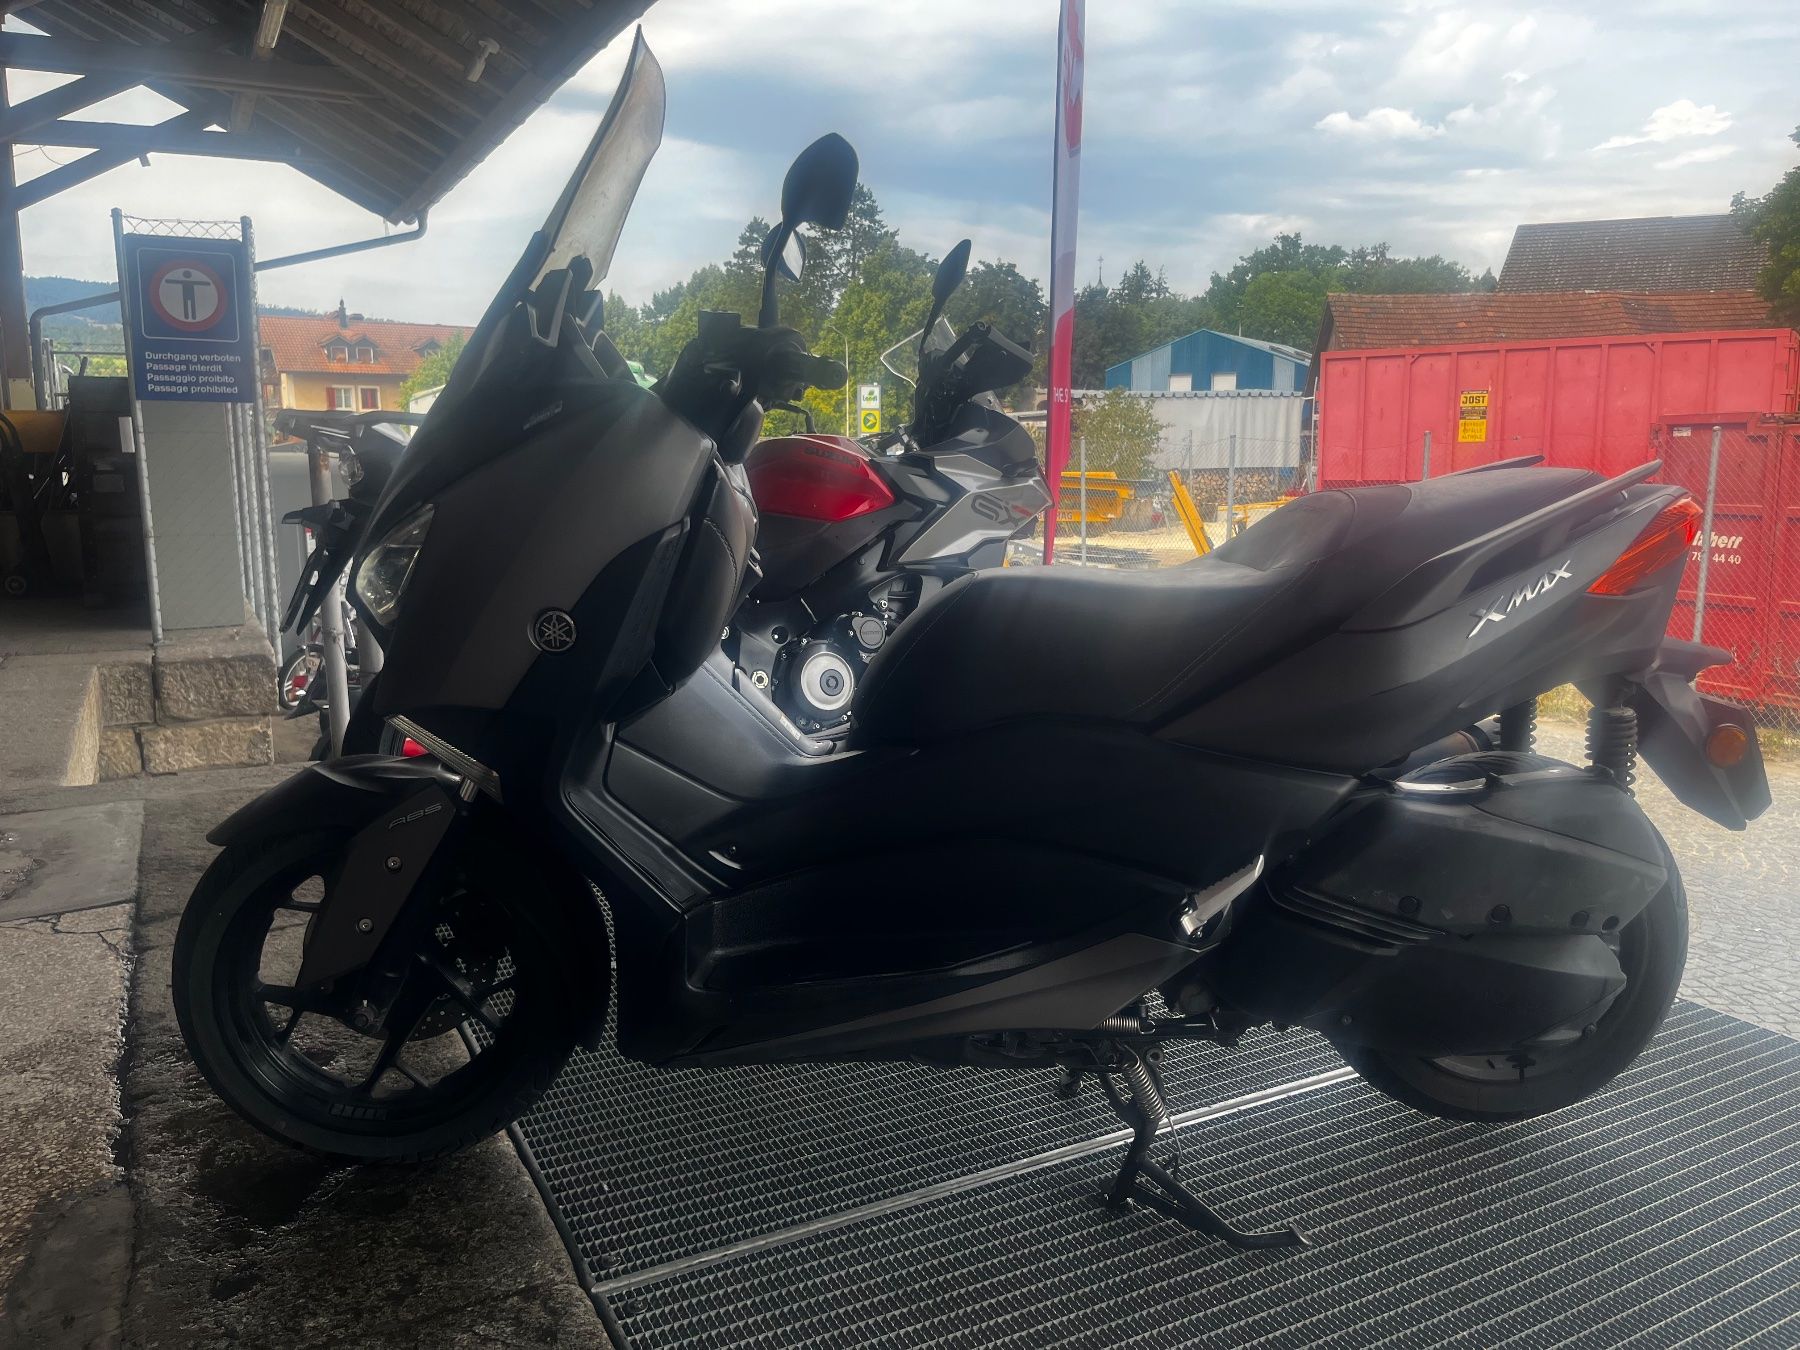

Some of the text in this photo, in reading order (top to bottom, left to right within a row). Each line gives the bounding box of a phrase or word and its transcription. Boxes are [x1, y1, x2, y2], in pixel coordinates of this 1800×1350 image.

[145, 352, 241, 363] Durchgang verboten
[146, 363, 223, 372] Passage interdit
[147, 373, 235, 384] Passaggio proibito
[148, 384, 238, 394] Passage prohibited
[1461, 395, 1487, 405] JOST
[1712, 553, 1726, 563] 44
[1727, 554, 1742, 565] 40
[388, 803, 442, 830] ABS
